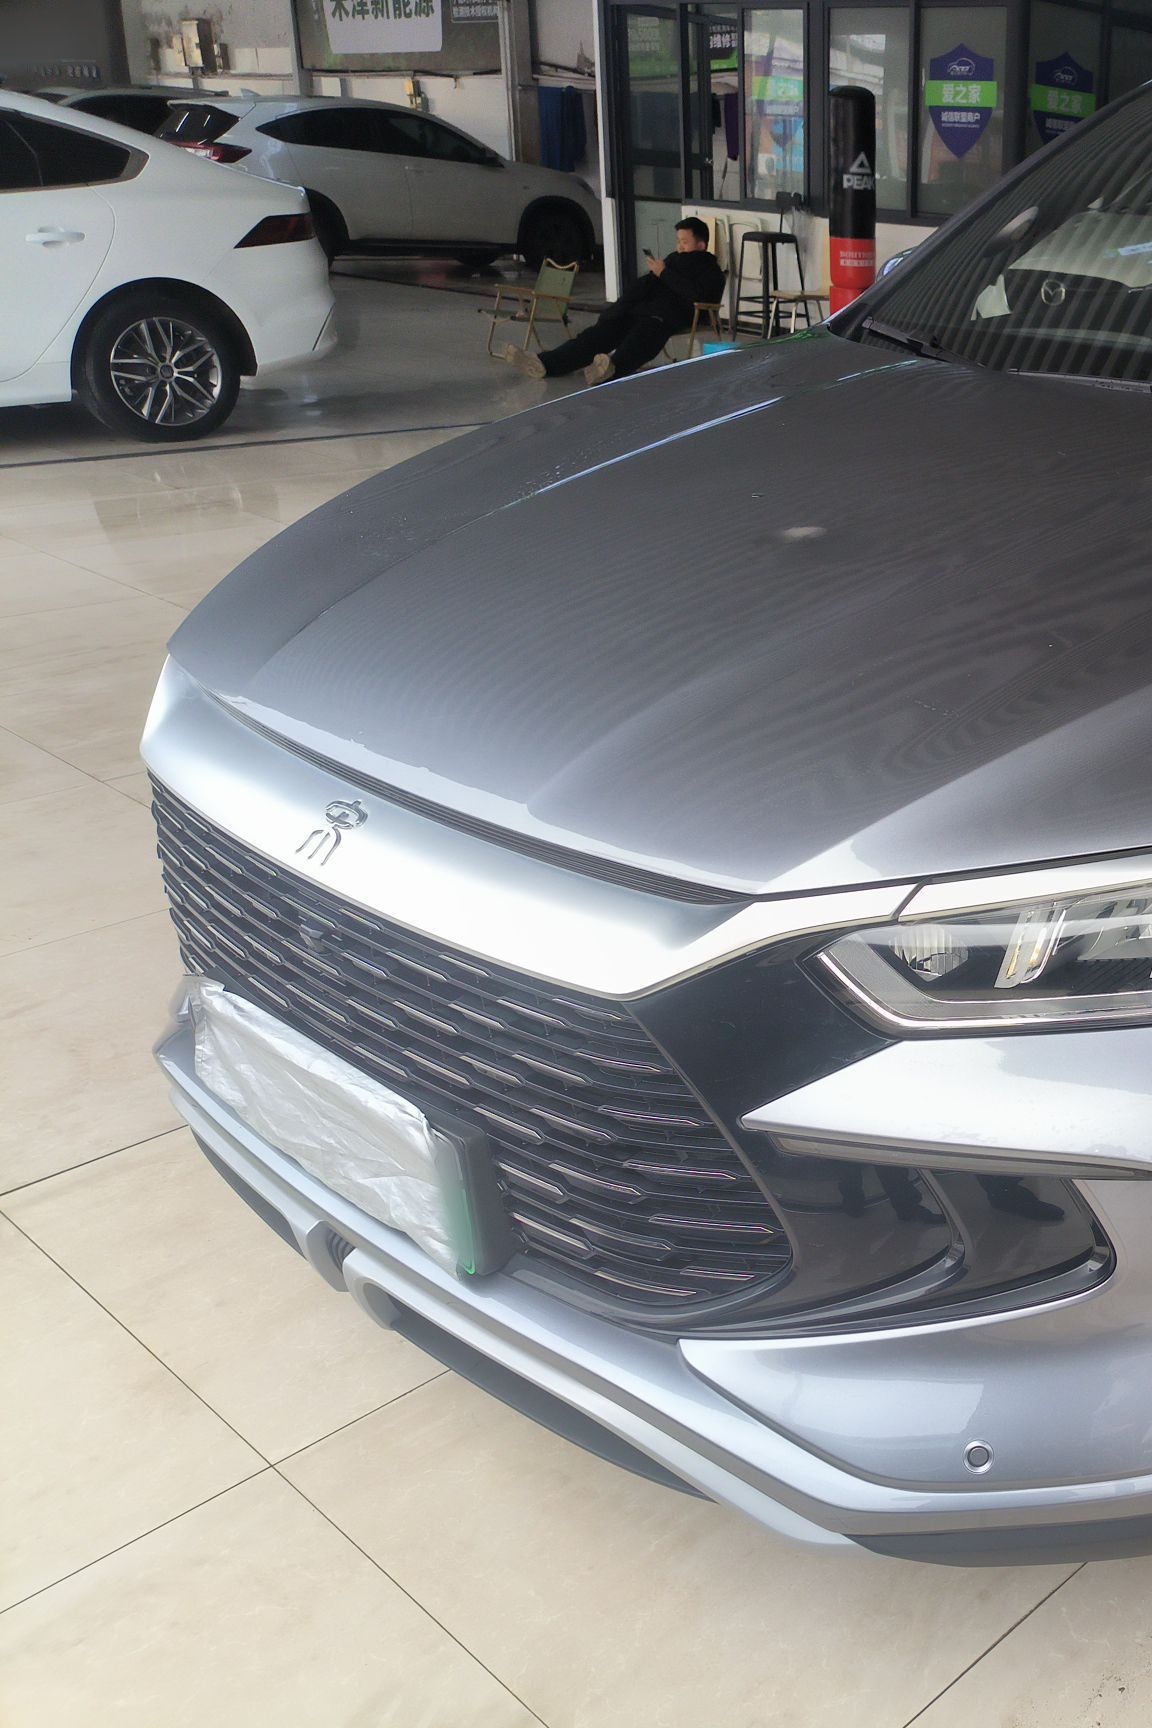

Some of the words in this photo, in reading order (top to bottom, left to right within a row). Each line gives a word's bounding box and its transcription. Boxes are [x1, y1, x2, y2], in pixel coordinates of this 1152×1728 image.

[943, 84, 982, 104] 爱之家
[843, 173, 876, 190] PEAK
